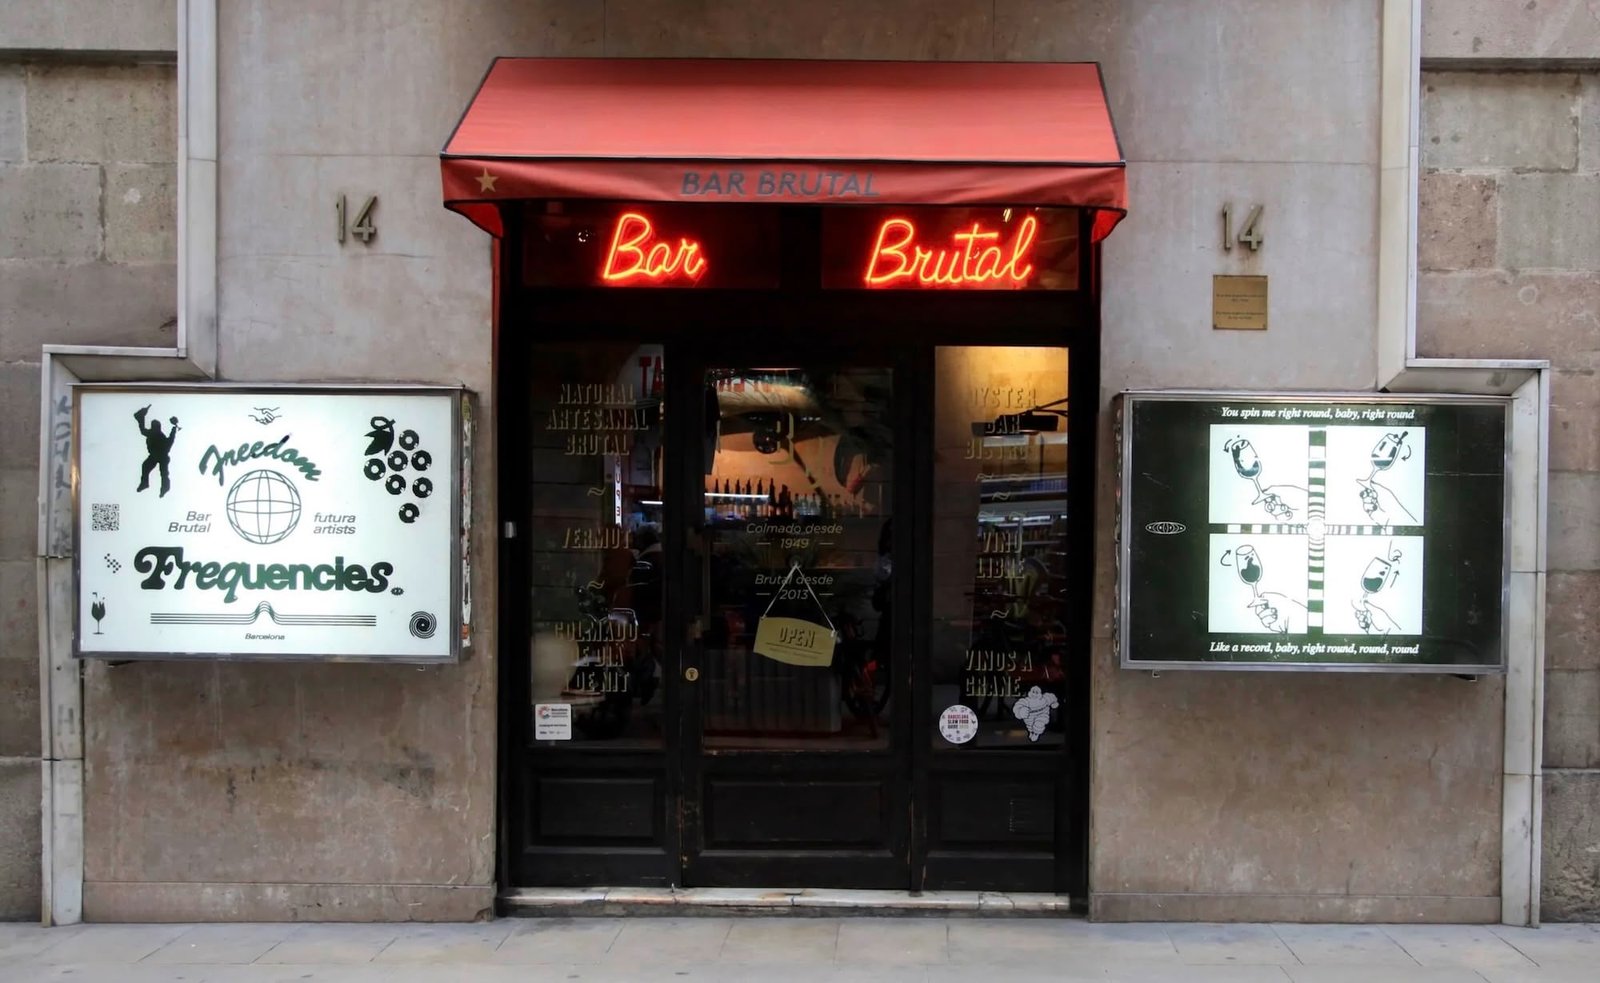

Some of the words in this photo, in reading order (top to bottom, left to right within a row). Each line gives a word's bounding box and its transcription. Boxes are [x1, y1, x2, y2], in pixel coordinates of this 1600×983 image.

[680, 171, 746, 196] BAR
[756, 171, 880, 197] BRUTAL
[336, 194, 377, 246] 14
[1222, 202, 1264, 252] 14
[602, 212, 705, 280] Bar
[865, 216, 1037, 283] Brutal
[1221, 407, 1239, 417] You
[1240, 408, 1260, 419] spin
[1262, 410, 1276, 418] me
[1278, 408, 1301, 420] right
[1303, 409, 1333, 419] round,
[1335, 408, 1360, 421] baby,
[1362, 409, 1385, 421] right
[1387, 409, 1415, 419] round
[186, 511, 212, 522] Bar
[313, 512, 356, 523] futura
[167, 522, 212, 534] Brutal
[313, 523, 356, 535] artists
[746, 523, 802, 535] Colmado
[805, 523, 844, 535] desde
[780, 538, 809, 549] 1949
[755, 574, 792, 585] Brutal
[796, 574, 834, 585] desde
[779, 589, 809, 600] 2013
[245, 632, 285, 640] Barcelona
[778, 626, 816, 648] OPEN
[1209, 642, 1230, 652] Like
[1240, 642, 1273, 654] record,
[1275, 642, 1300, 655] baby,
[1302, 643, 1325, 655] right
[1327, 643, 1357, 654] round,
[1359, 644, 1389, 655] round,
[1391, 644, 1419, 654] round
